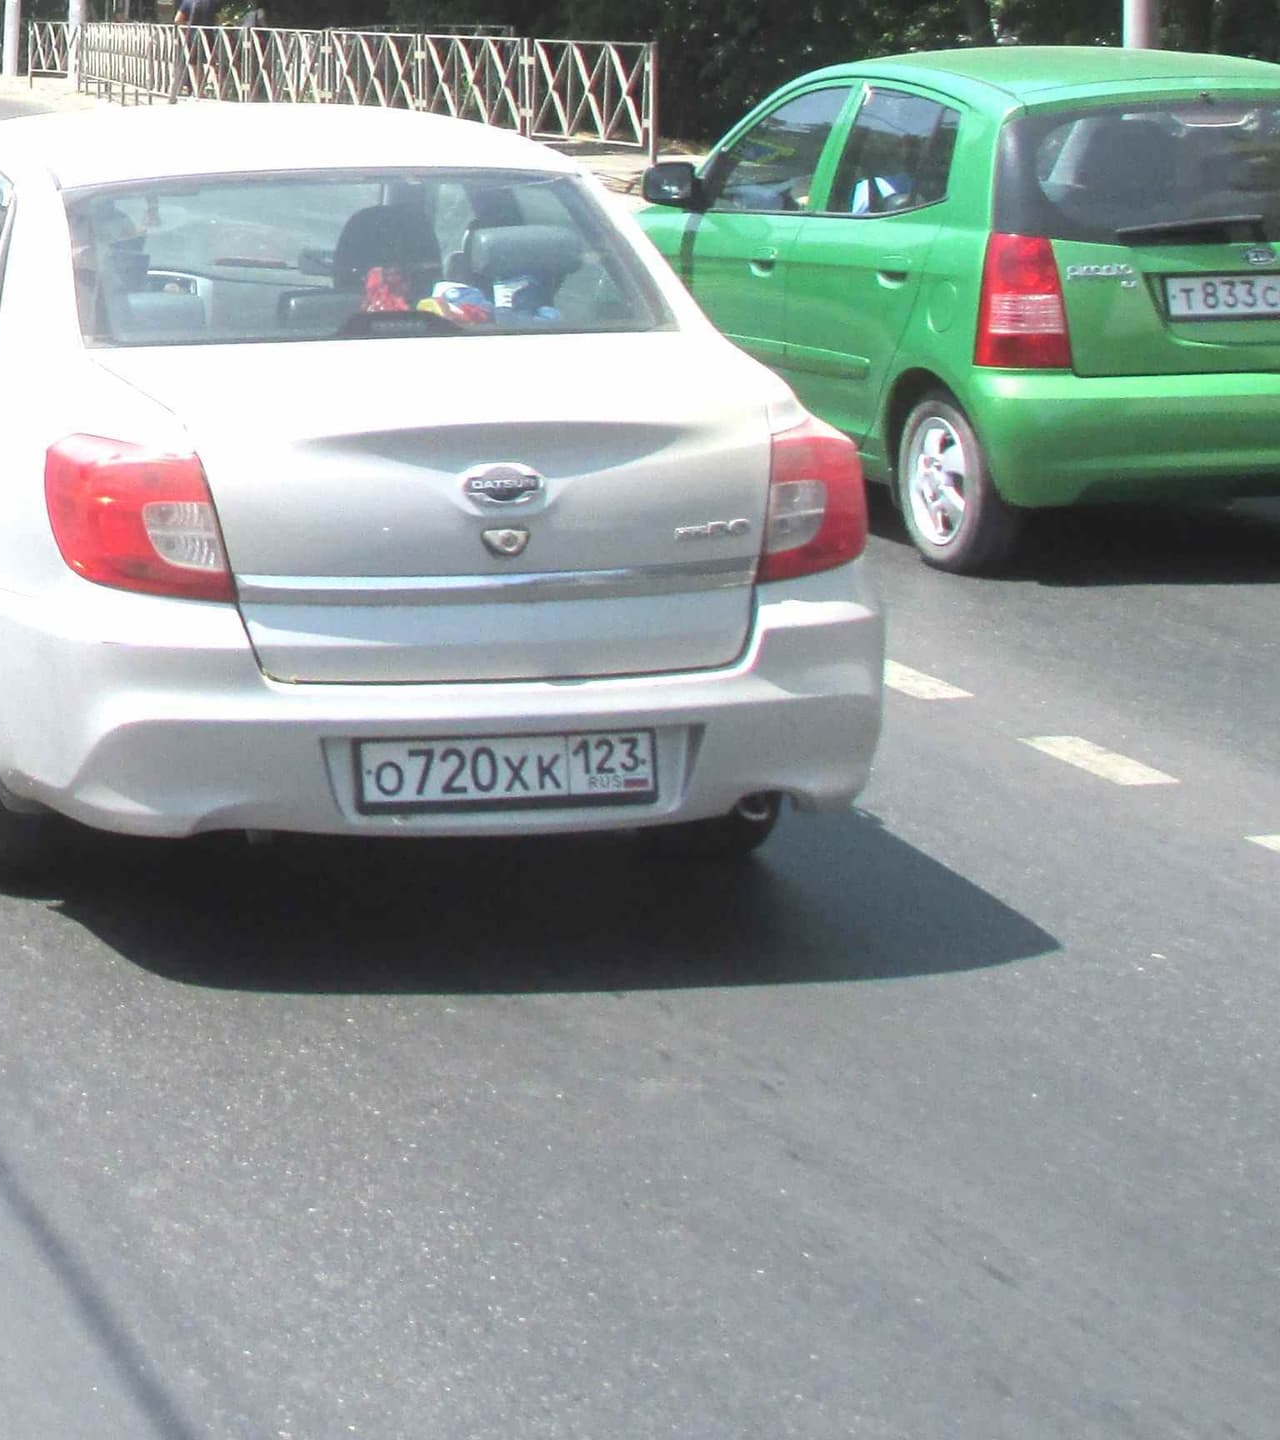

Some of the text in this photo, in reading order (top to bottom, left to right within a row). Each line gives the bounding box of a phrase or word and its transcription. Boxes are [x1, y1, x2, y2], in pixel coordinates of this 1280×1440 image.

[374, 735, 642, 797] О720ХК 123
[588, 773, 624, 790] RUS
